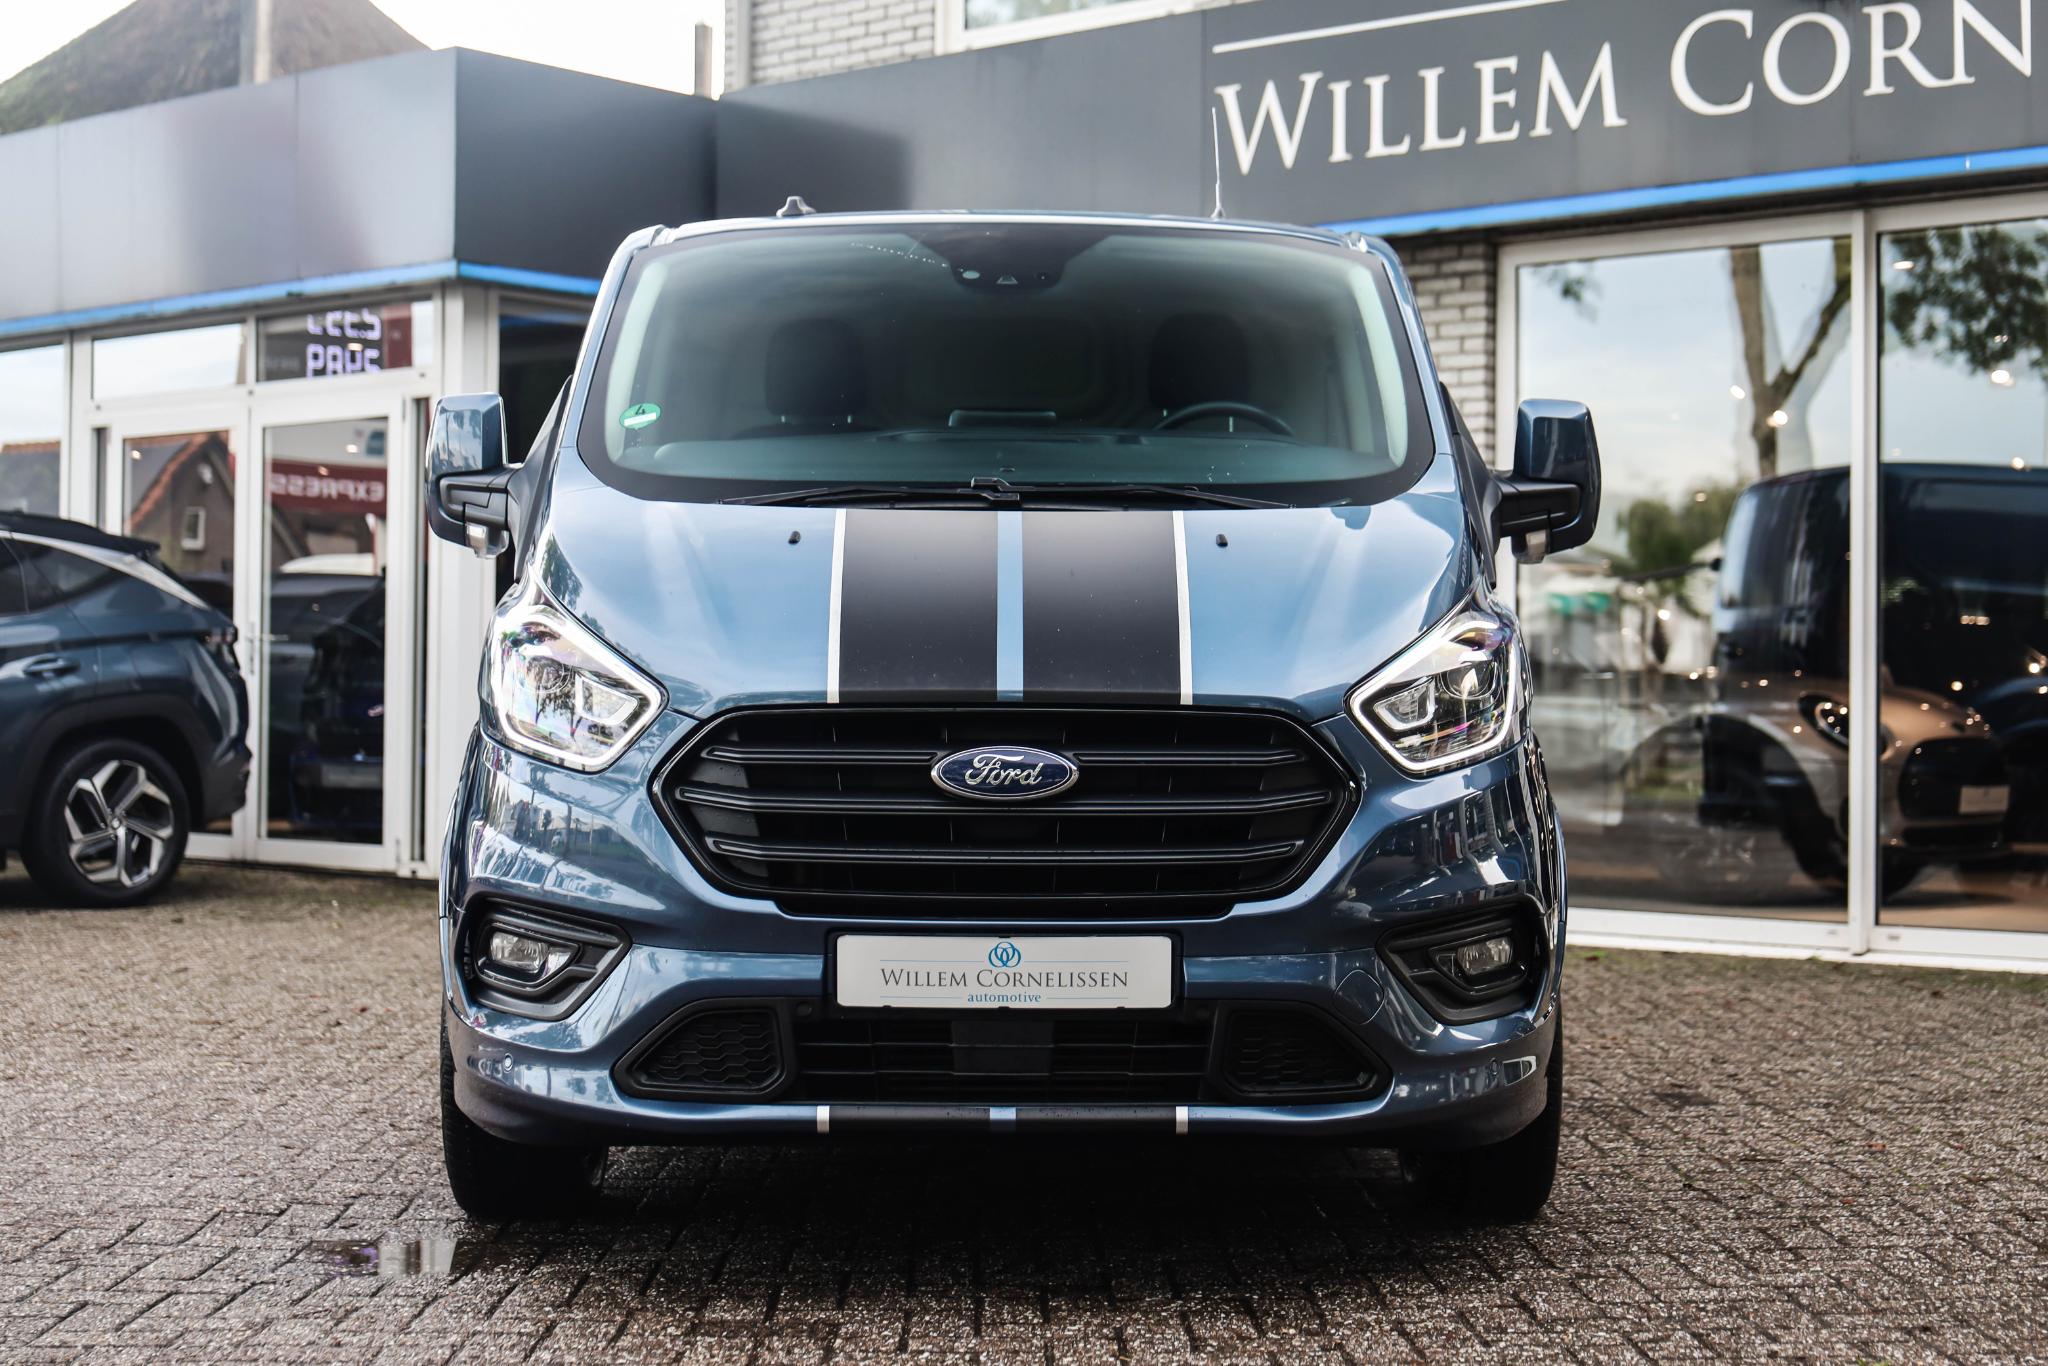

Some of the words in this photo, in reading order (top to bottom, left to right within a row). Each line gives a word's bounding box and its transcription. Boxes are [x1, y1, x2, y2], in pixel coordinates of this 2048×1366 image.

[1215, 41, 1627, 175] WILLEM
[965, 753, 1044, 785] Ford
[880, 968, 968, 988] WILLEM
[976, 968, 1129, 988] CORNELISSEN
[967, 991, 1042, 1004] automotive
